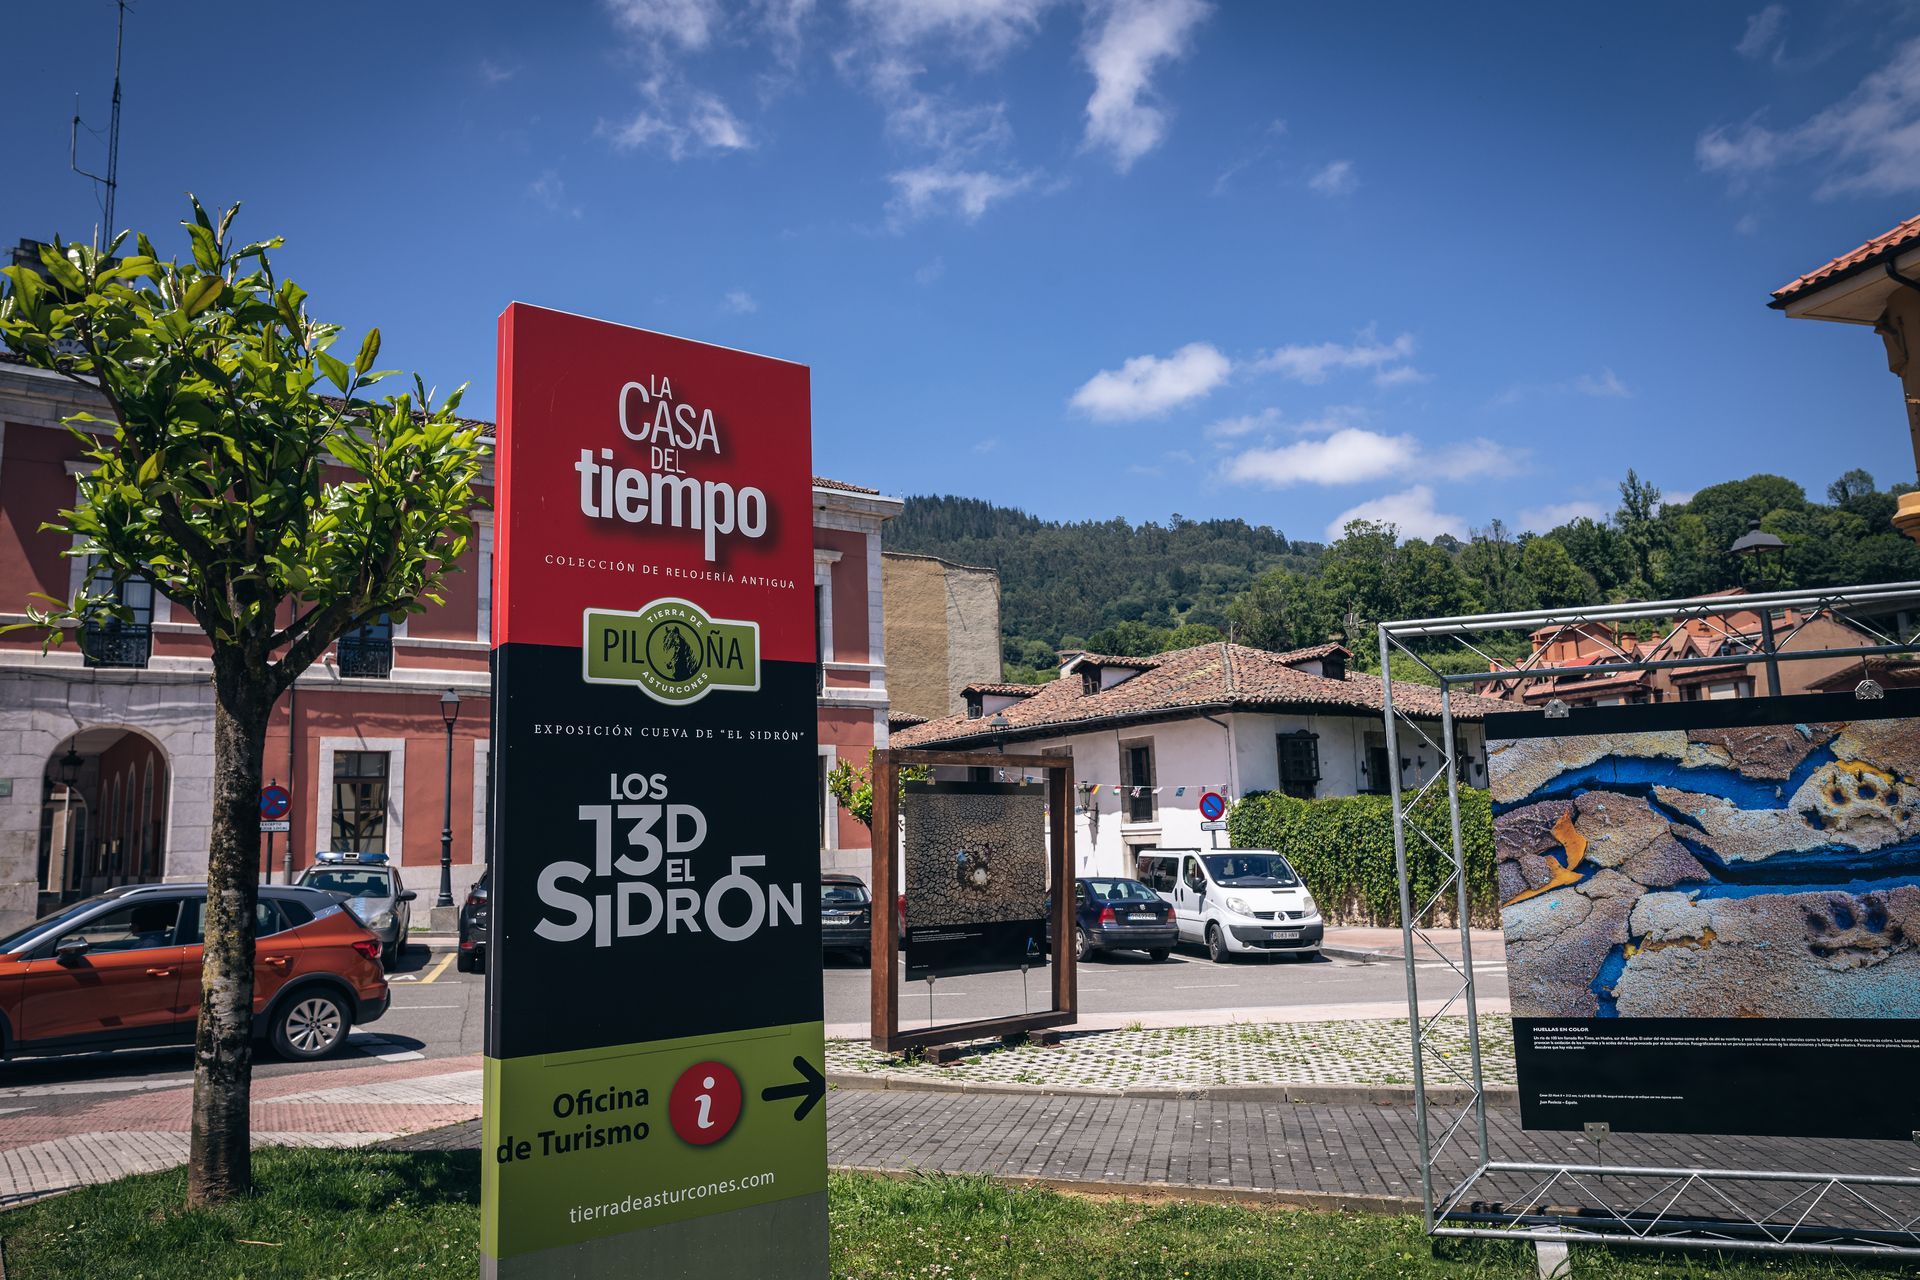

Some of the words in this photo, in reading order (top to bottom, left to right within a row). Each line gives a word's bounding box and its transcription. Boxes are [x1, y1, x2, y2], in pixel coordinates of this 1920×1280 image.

[651, 374, 672, 400] LA
[618, 381, 720, 454] CASA
[651, 446, 686, 474] DEL
[575, 448, 767, 562] tiempo
[545, 554, 635, 573] COLECCIÓN
[643, 564, 659, 576] DE
[666, 566, 734, 583] RELOJERÍA
[741, 576, 795, 590] ANTIGUA
[647, 608, 685, 624] TIERRA
[689, 615, 703, 628] DE
[642, 671, 708, 695] ASTURCONES
[534, 723, 633, 737] EXPOSICIÓN
[641, 727, 687, 739] CUEVA
[696, 729, 713, 739] DE
[610, 773, 667, 800] LOS
[667, 859, 694, 882] EL
[553, 1086, 649, 1119] Oficina
[497, 1135, 531, 1163] de
[538, 1122, 650, 1156] Turismo
[569, 1169, 775, 1224] tierradeasturcones.com
